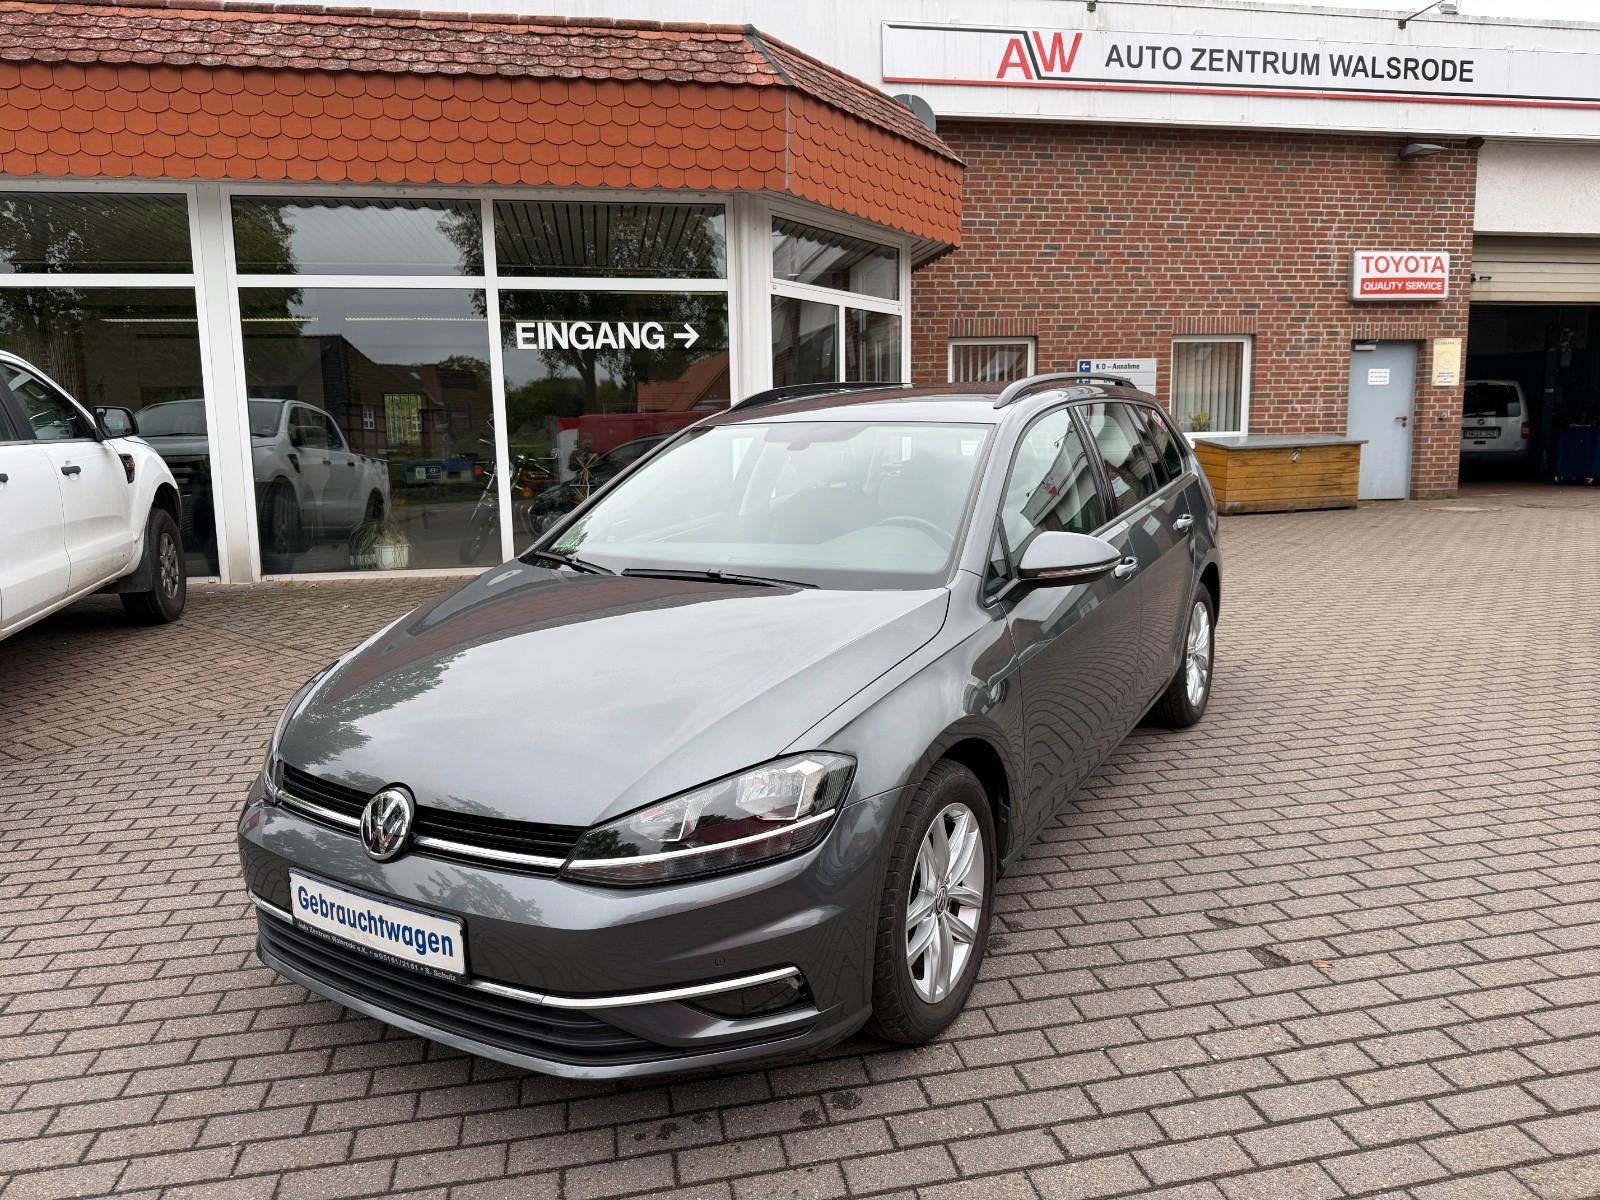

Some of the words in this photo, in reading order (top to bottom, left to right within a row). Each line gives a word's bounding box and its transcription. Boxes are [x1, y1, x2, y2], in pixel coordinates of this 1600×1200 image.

[996, 30, 1083, 80] AW
[1105, 44, 1182, 72] AUTO
[1189, 47, 1320, 77] ZENTRUM
[1329, 53, 1475, 83] WALSRODE
[1361, 255, 1446, 274] TOYOTA
[1363, 281, 1404, 291] QUALITY
[1405, 281, 1443, 291] SERVICE
[515, 321, 665, 350] EINGANG
[298, 885, 454, 958] Gebrauchtwagen
